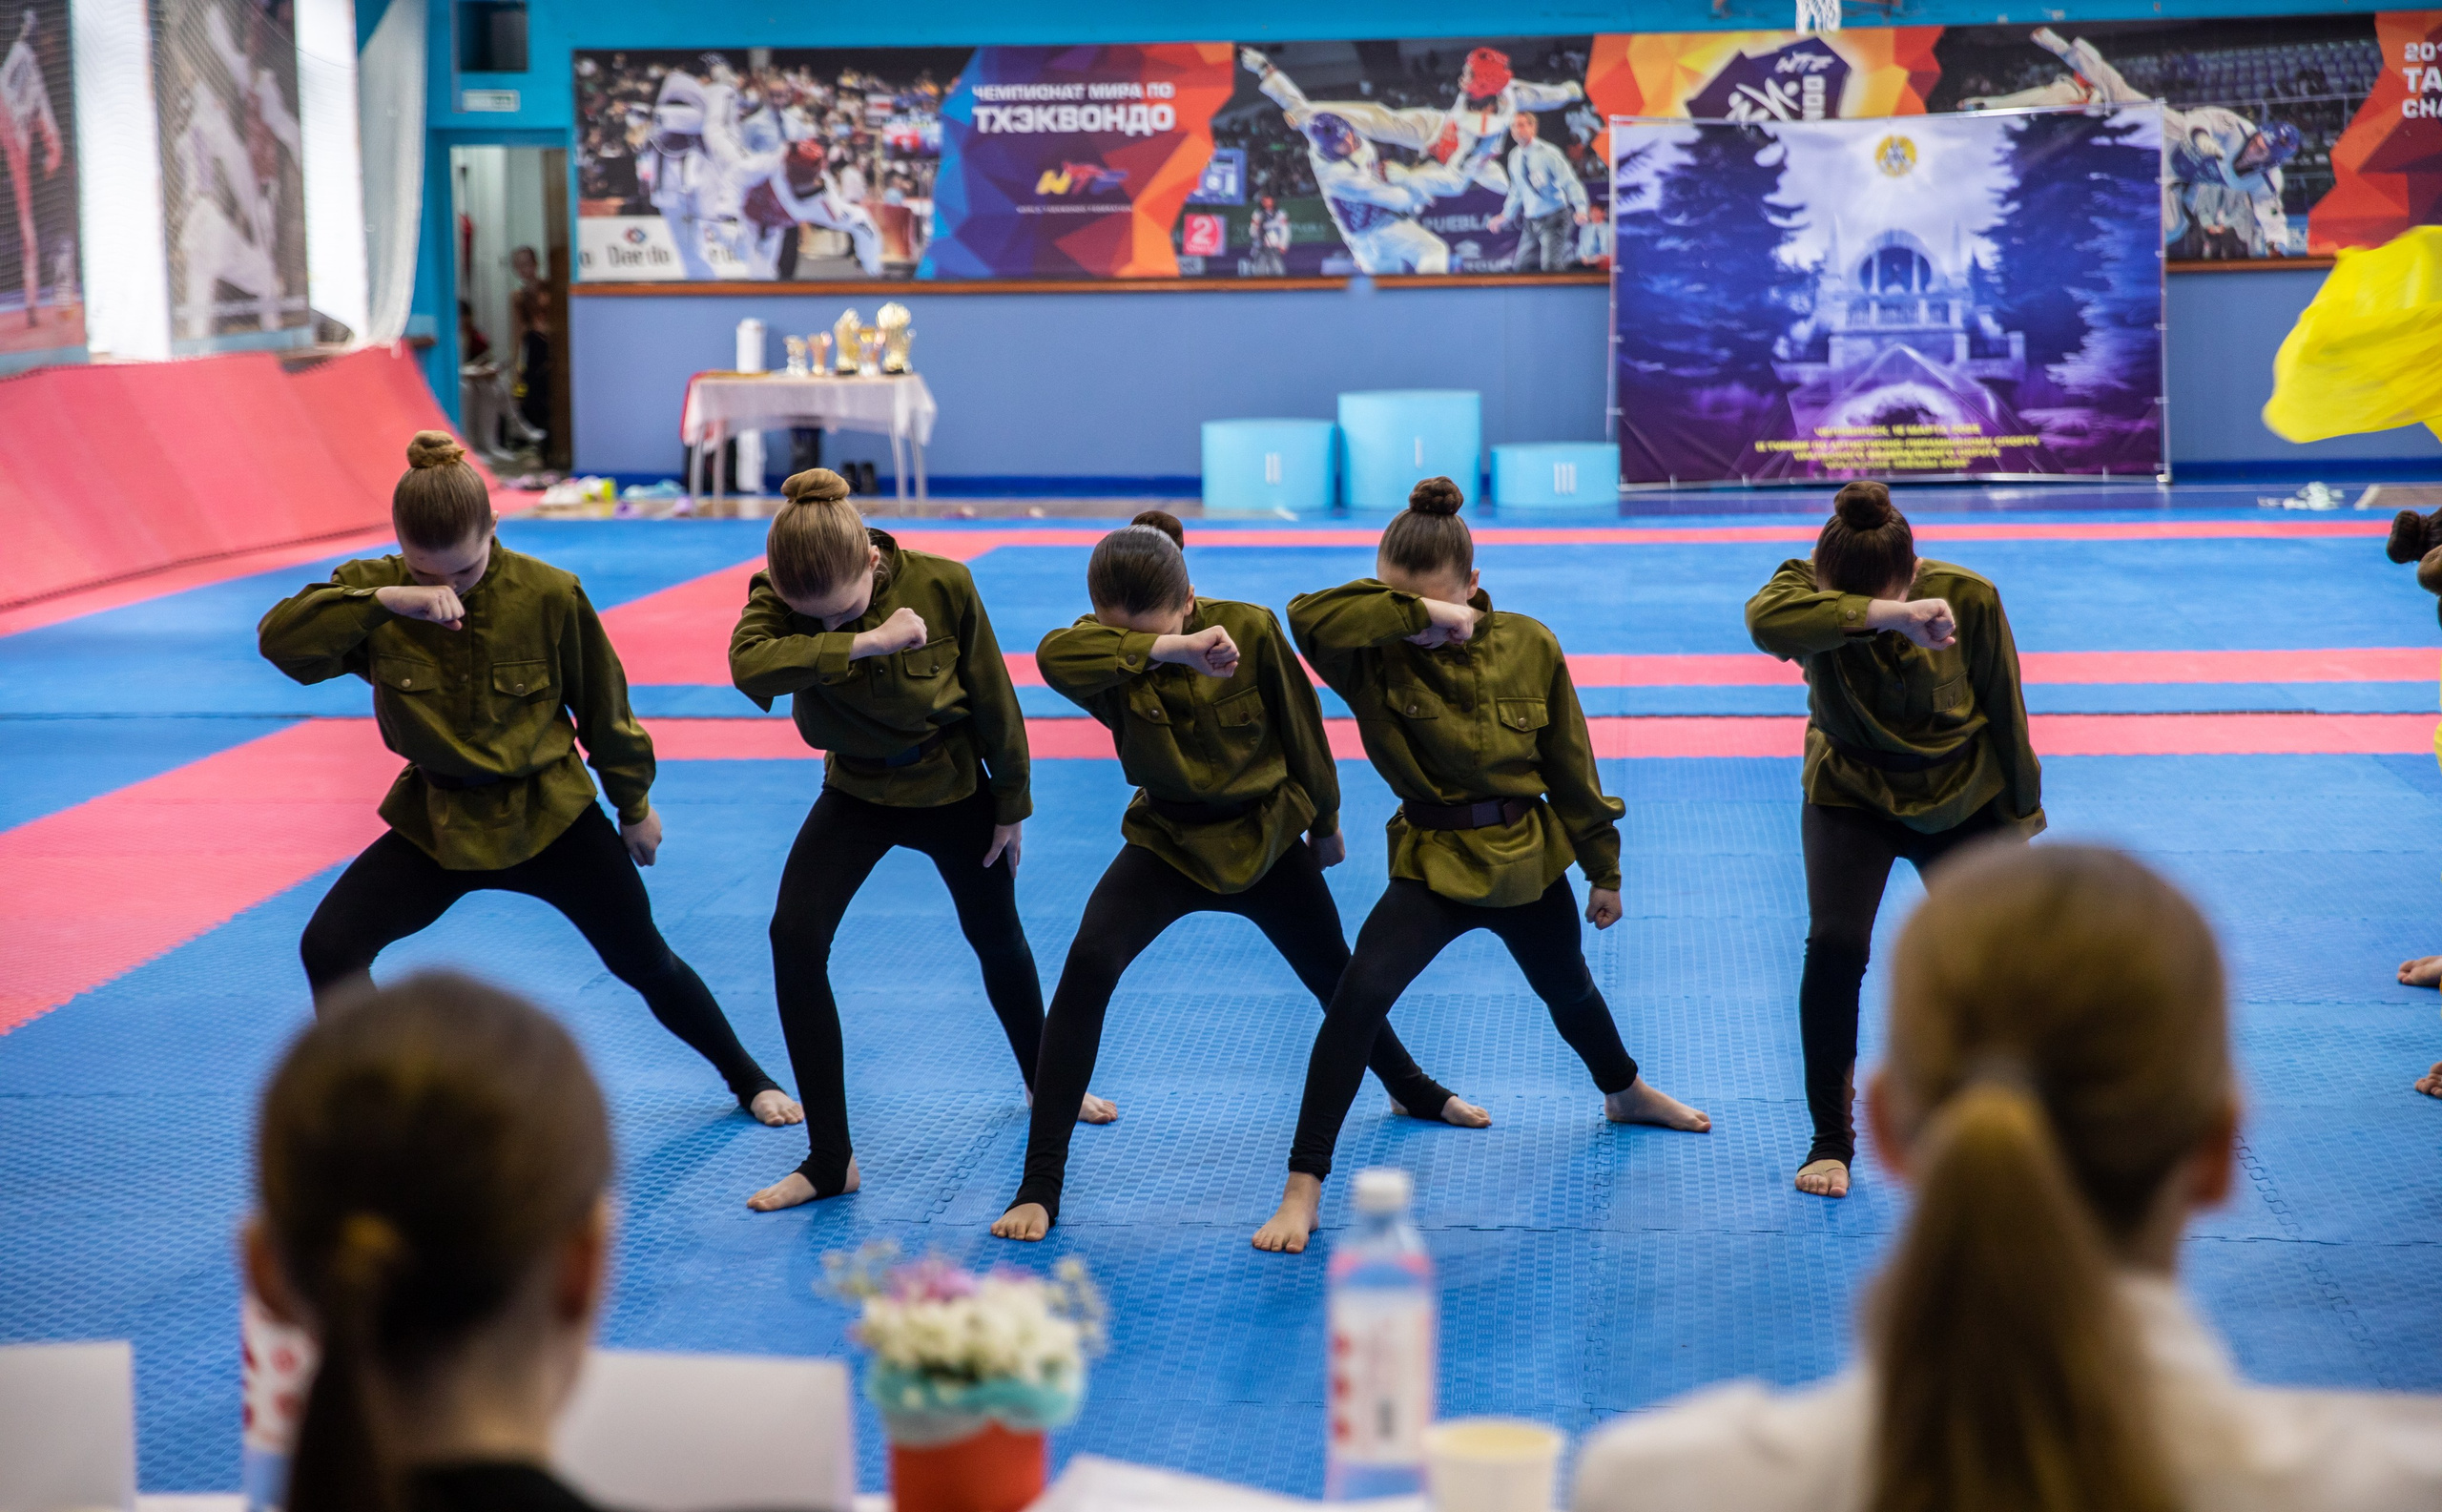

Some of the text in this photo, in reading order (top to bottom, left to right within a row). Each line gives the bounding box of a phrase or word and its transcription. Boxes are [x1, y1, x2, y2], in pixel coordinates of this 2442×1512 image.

[972, 81, 1176, 101] ЧЕМПИОНАТ МИРА ПО
[972, 103, 1176, 136] ТХЭКВОНДО
[2402, 97, 2442, 118] CH
[1191, 216, 1212, 244] 2
